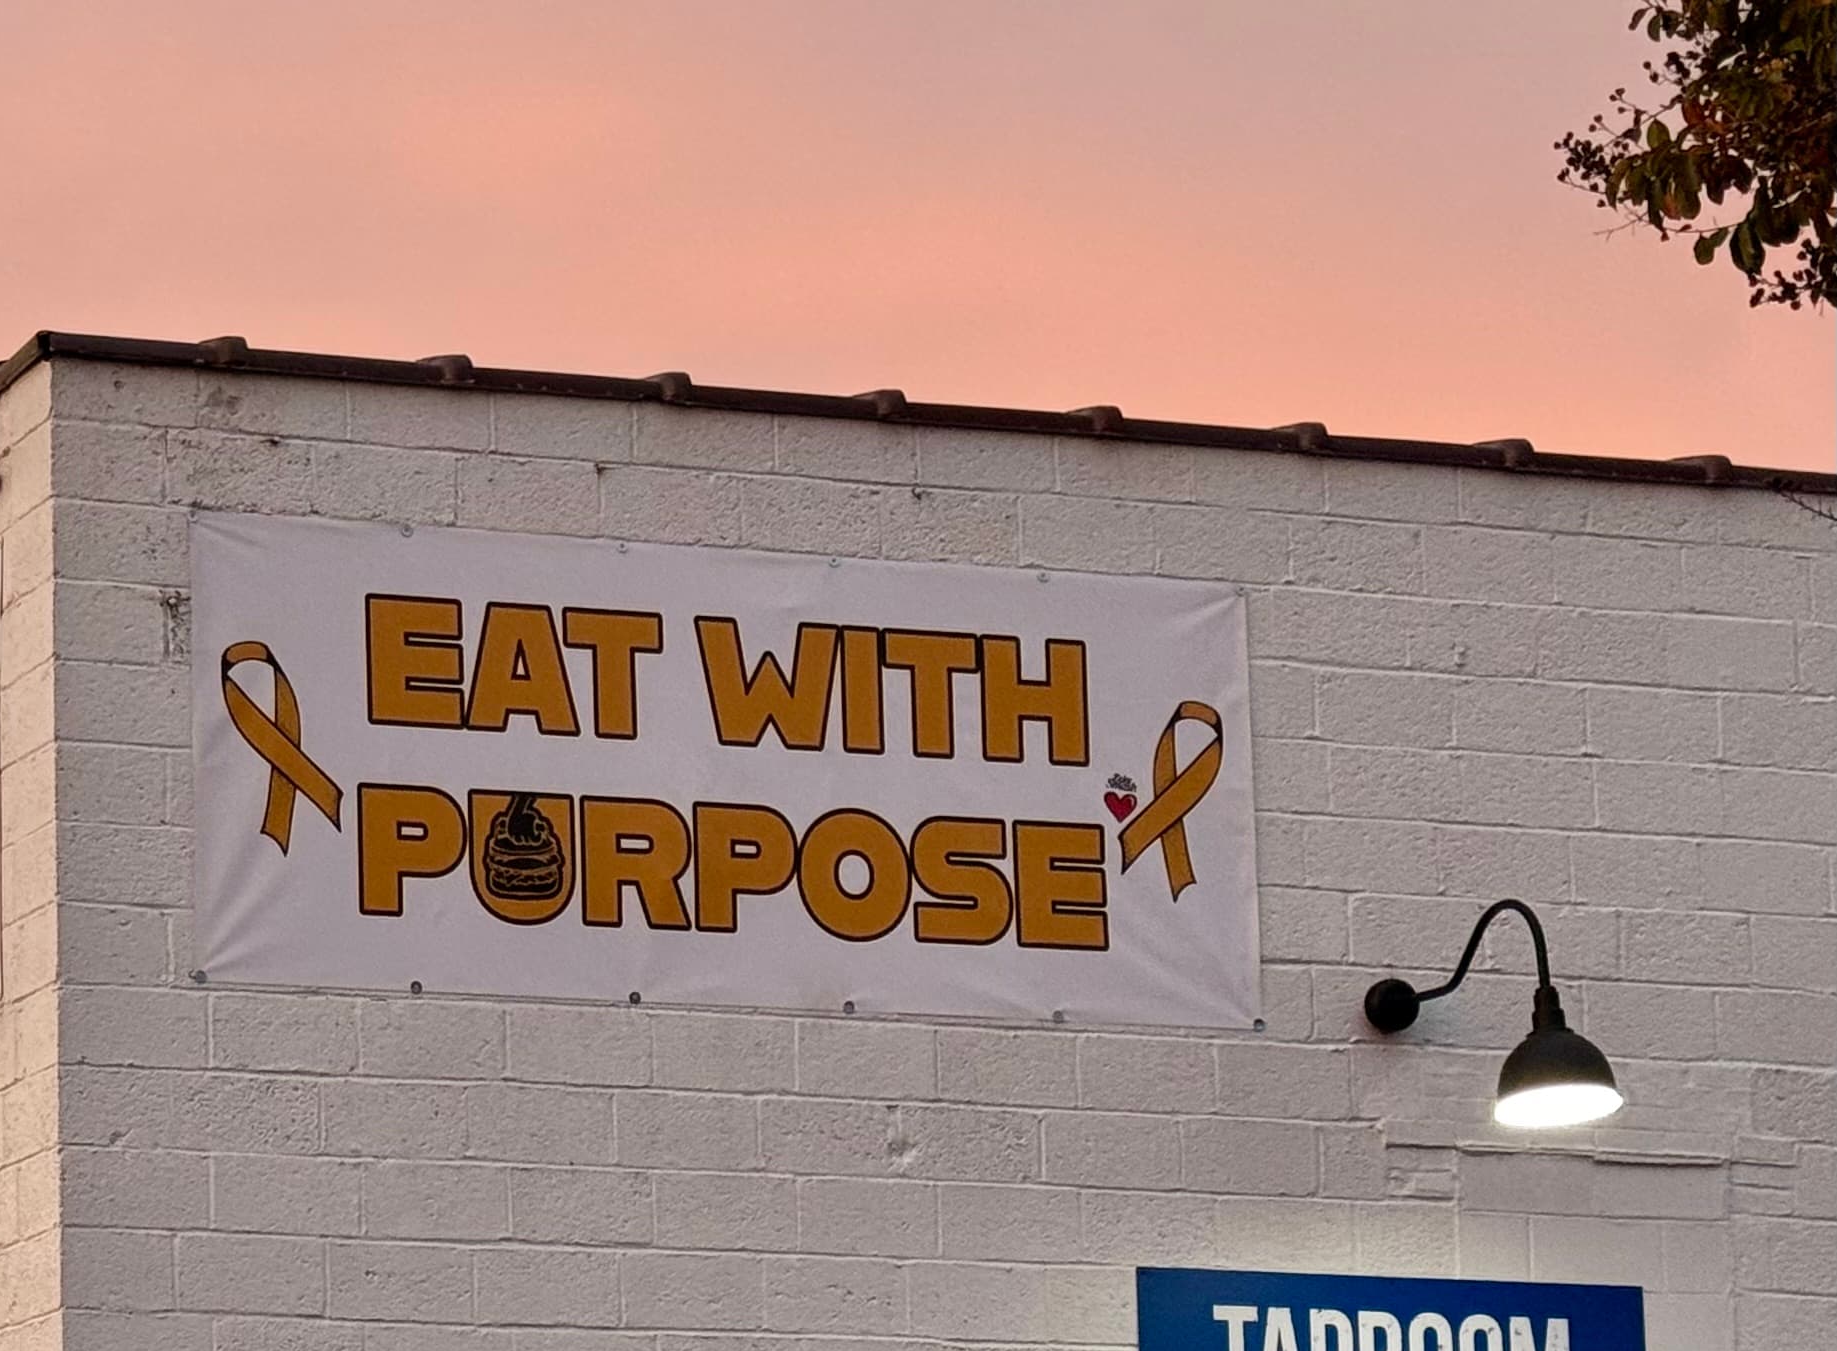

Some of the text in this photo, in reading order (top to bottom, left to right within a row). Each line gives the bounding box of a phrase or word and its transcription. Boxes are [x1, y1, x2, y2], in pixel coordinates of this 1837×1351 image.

[365, 594, 1090, 766] EAT WITH
[357, 776, 1109, 951] PURPOSE
